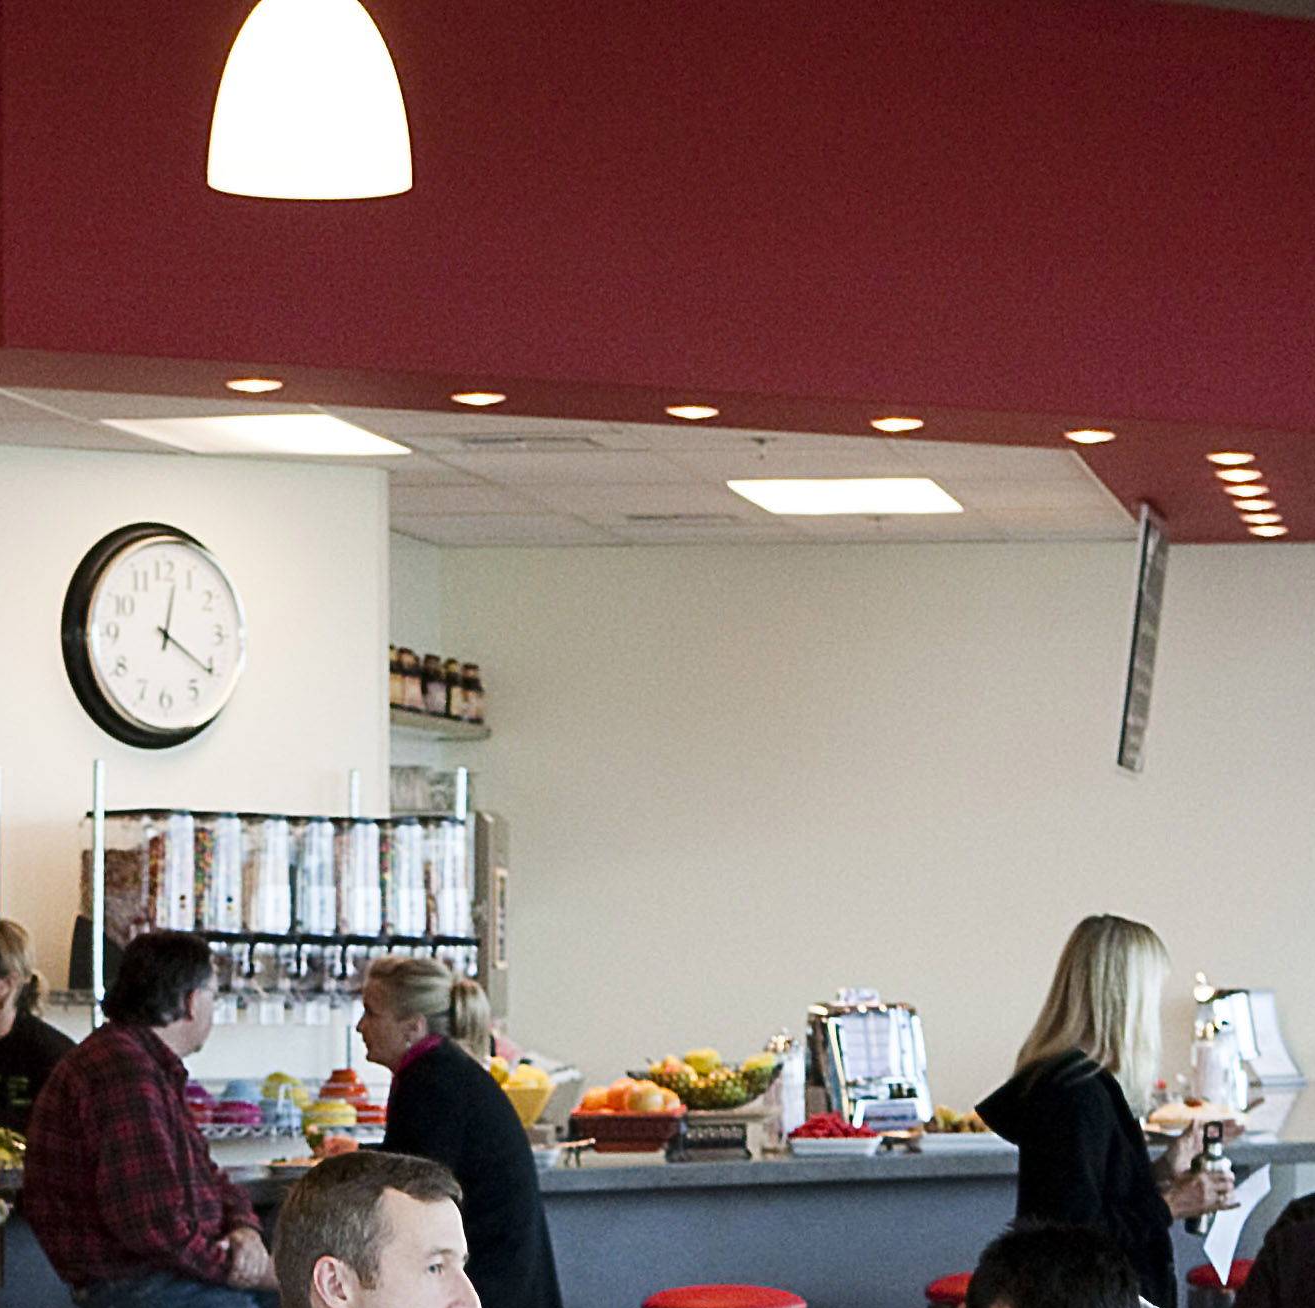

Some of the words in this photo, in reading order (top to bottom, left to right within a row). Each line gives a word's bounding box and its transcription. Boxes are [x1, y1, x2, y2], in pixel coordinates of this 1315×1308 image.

[133, 569, 149, 591] 11
[154, 560, 175, 582] 12
[114, 595, 135, 616] 10
[202, 591, 214, 612] 2
[106, 623, 120, 642] 9
[213, 624, 225, 646] 3
[115, 656, 129, 677] 8
[137, 679, 149, 700] 7
[159, 689, 173, 709] 6
[188, 679, 200, 699] 5
